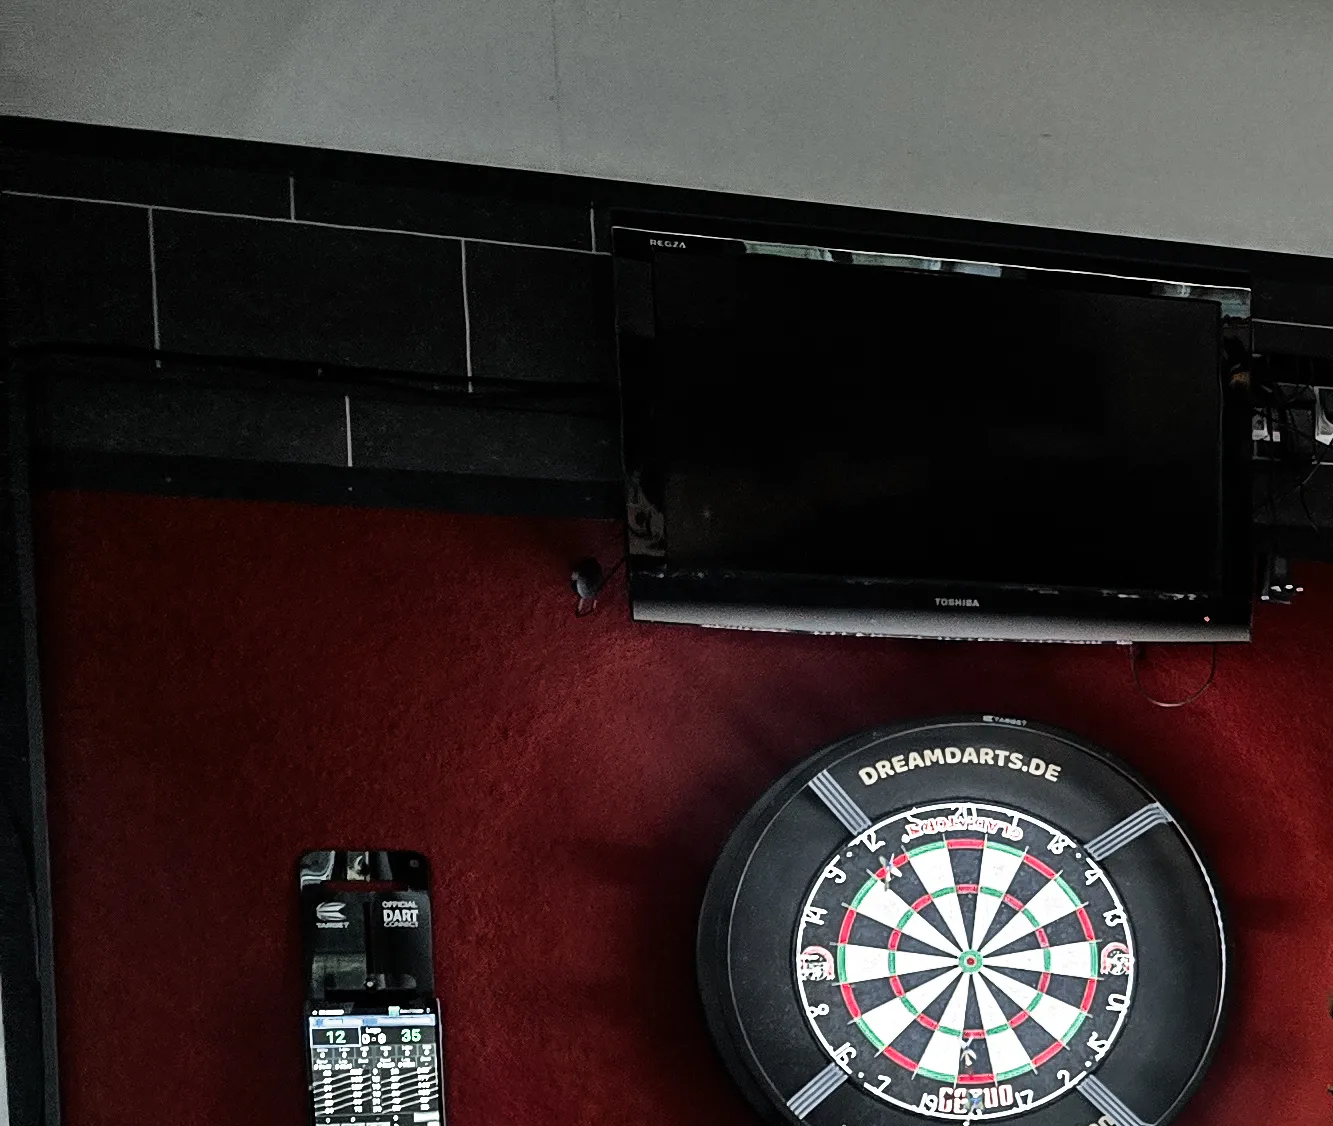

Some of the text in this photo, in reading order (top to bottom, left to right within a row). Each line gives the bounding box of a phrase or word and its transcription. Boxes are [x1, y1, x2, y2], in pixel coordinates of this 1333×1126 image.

[649, 239, 687, 248] REGZA
[934, 598, 980, 607] TOSHIBA
[858, 746, 1062, 787] DREAMDARTS.DE
[383, 909, 419, 922] DART
[326, 1030, 347, 1044] 12
[400, 1028, 422, 1043] 35
